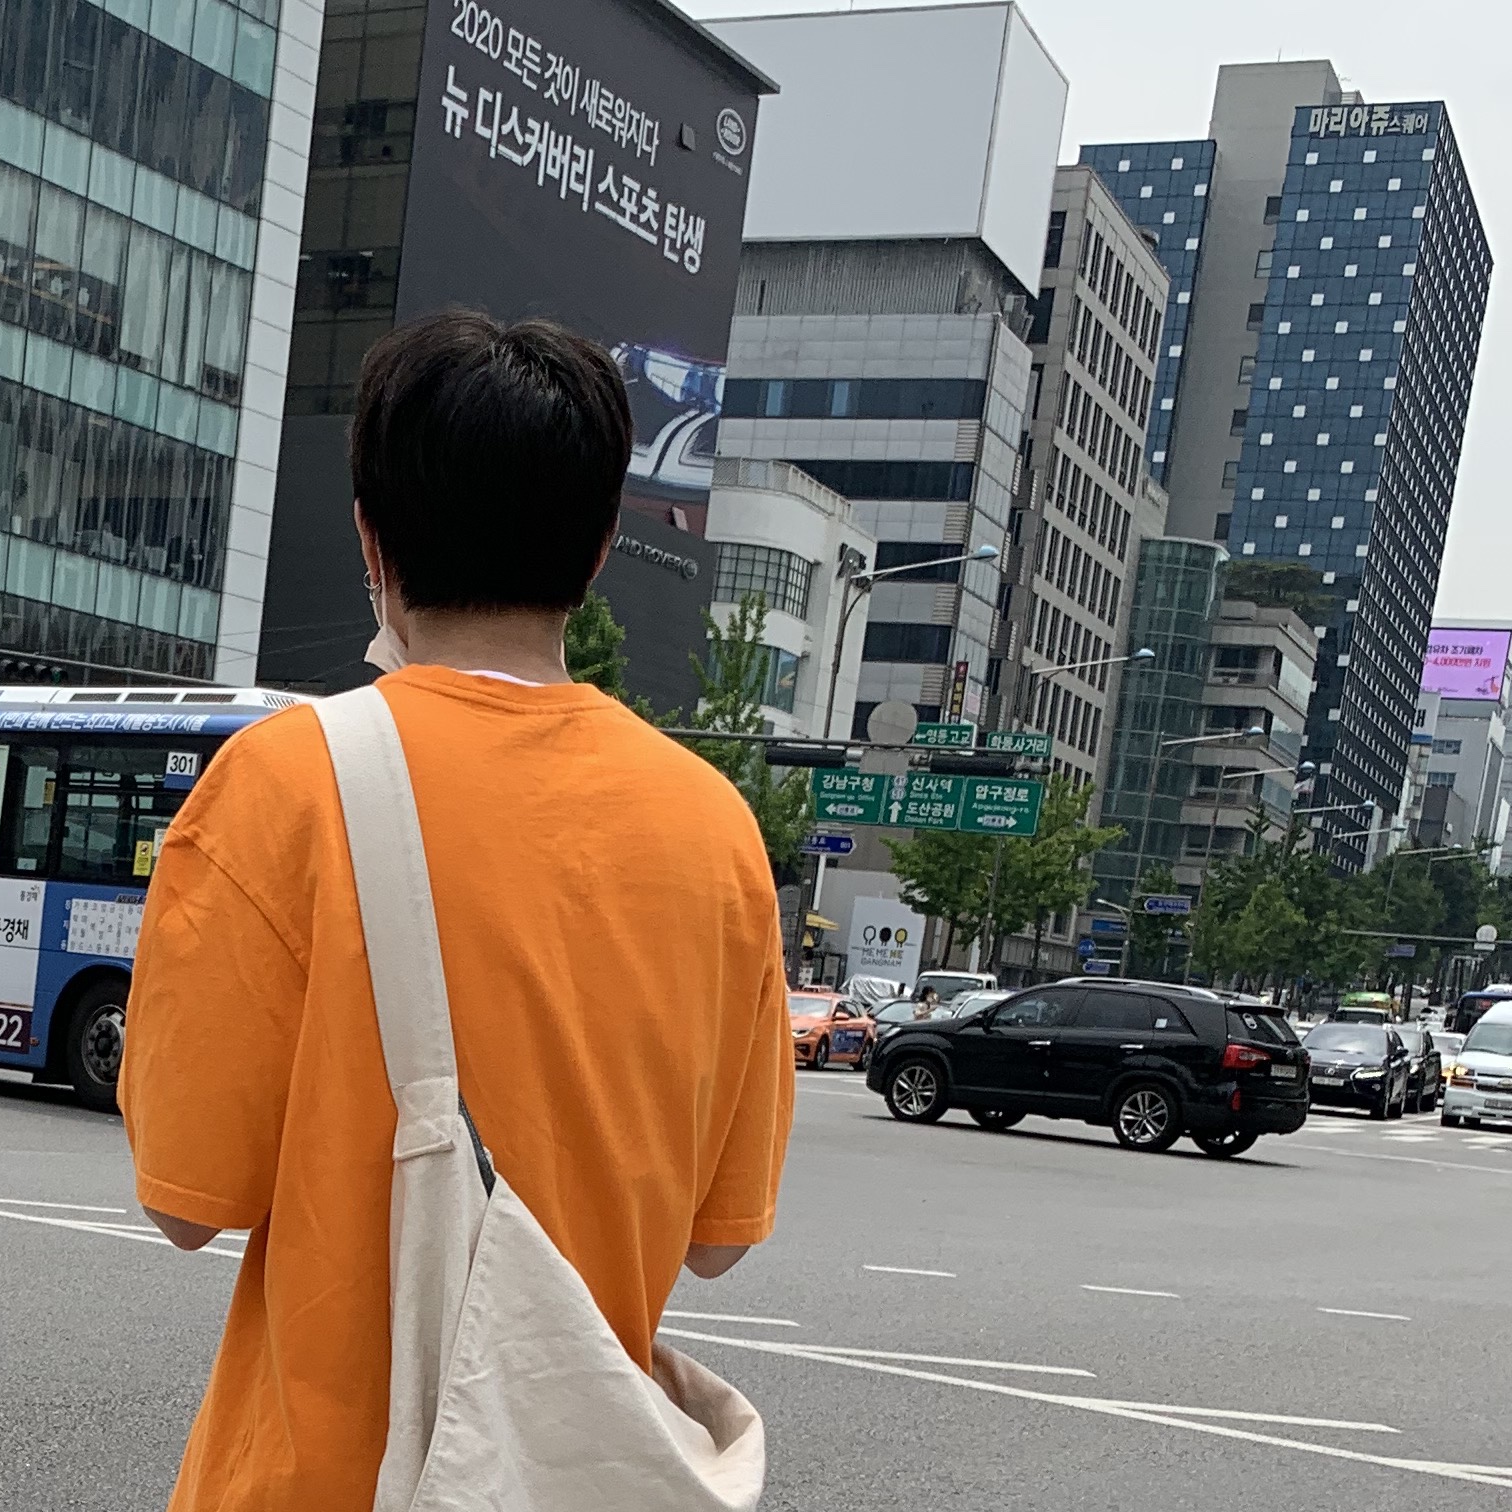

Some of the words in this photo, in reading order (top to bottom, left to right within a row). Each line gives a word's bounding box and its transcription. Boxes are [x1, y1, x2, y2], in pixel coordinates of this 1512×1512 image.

[451, 0, 503, 60] 2020
[503, 27, 541, 90] 모든
[544, 51, 580, 116] 것이
[580, 79, 659, 167] 새로워지다
[441, 65, 469, 138] 뉴
[475, 87, 593, 212] 디스커버리
[594, 165, 659, 245] 스포츠
[663, 203, 705, 274] 탄생
[615, 535, 642, 556] AND
[169, 754, 194, 774] 301
[822, 774, 875, 793] 강남구청
[911, 776, 953, 793] 신사역
[906, 801, 955, 818] 도산공원
